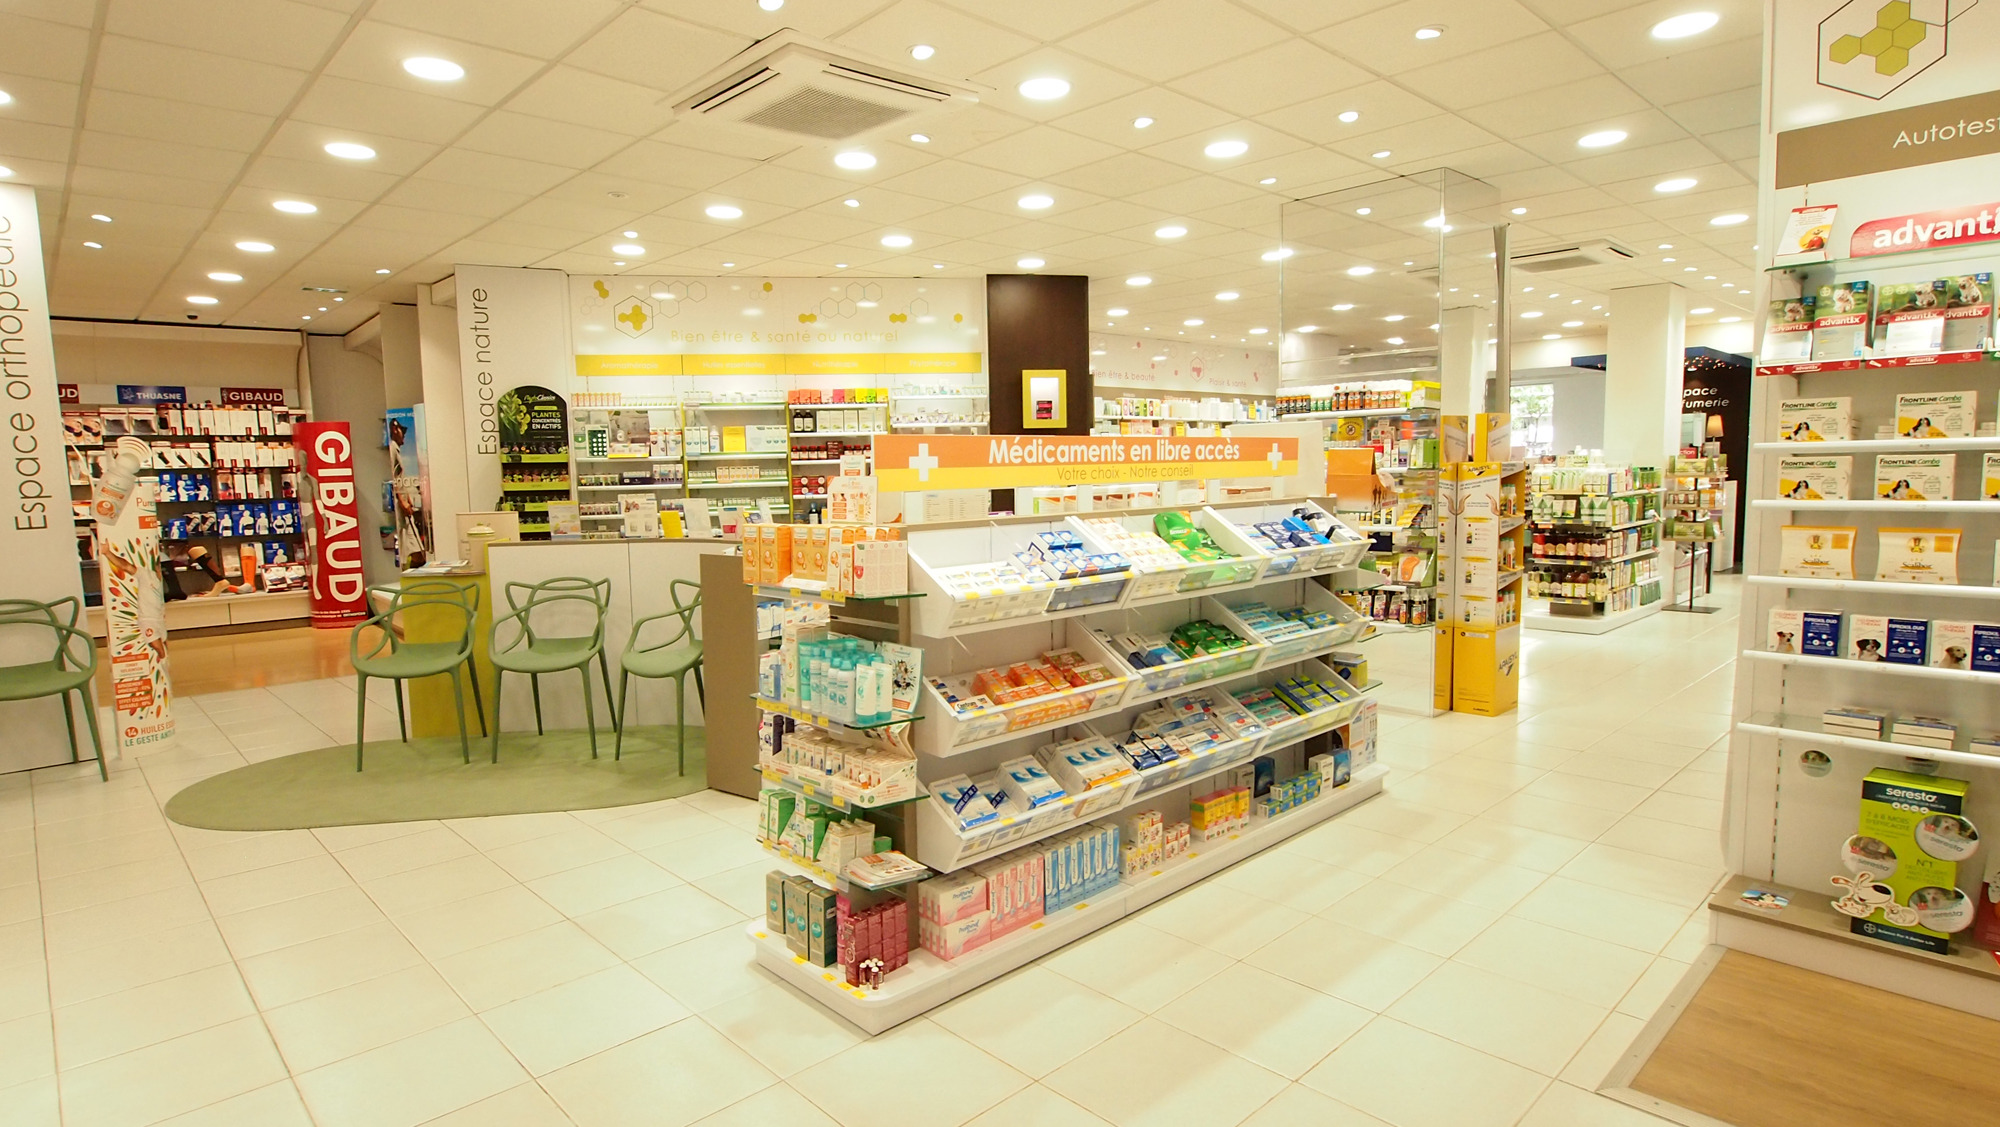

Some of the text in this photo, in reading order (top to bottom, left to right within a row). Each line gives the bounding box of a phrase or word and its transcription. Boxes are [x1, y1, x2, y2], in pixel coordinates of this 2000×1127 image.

[1819, 316, 1861, 327] advantix
[1894, 312, 1938, 322] advantix
[1771, 323, 1809, 332] advantix
[671, 330, 705, 343] Bien
[711, 330, 744, 343] être
[750, 331, 761, 343] &
[767, 330, 811, 343] santé
[843, 330, 898, 342] naturel
[470, 287, 500, 455] Espace nature
[136, 391, 182, 400] THUASNE
[229, 390, 283, 402] GIBAUD
[1683, 387, 1718, 398] pace
[1900, 394, 1962, 404] FRONTLINE Combo
[1681, 398, 1730, 409] fumerie
[988, 435, 1240, 464] Médicaments en libre accès
[1917, 457, 1941, 465] Combo
[10, 412, 52, 530] Espace
[1057, 467, 1087, 481] Votre
[1091, 466, 1120, 480] choix
[1130, 465, 1158, 478] Notre
[1160, 464, 1194, 477] conseil
[314, 430, 364, 603] GIBAUD
[1498, 651, 1518, 672] APAISYL
[956, 701, 977, 710] Centrum
[126, 727, 137, 737] 14
[140, 724, 165, 735] HUILES
[124, 737, 135, 747] LE
[136, 734, 159, 745] GESTE
[1886, 787, 1938, 803] seresto
[1930, 836, 1964, 853] seresto
[1858, 857, 1890, 872] seresto
[1931, 909, 1963, 918] seresto
